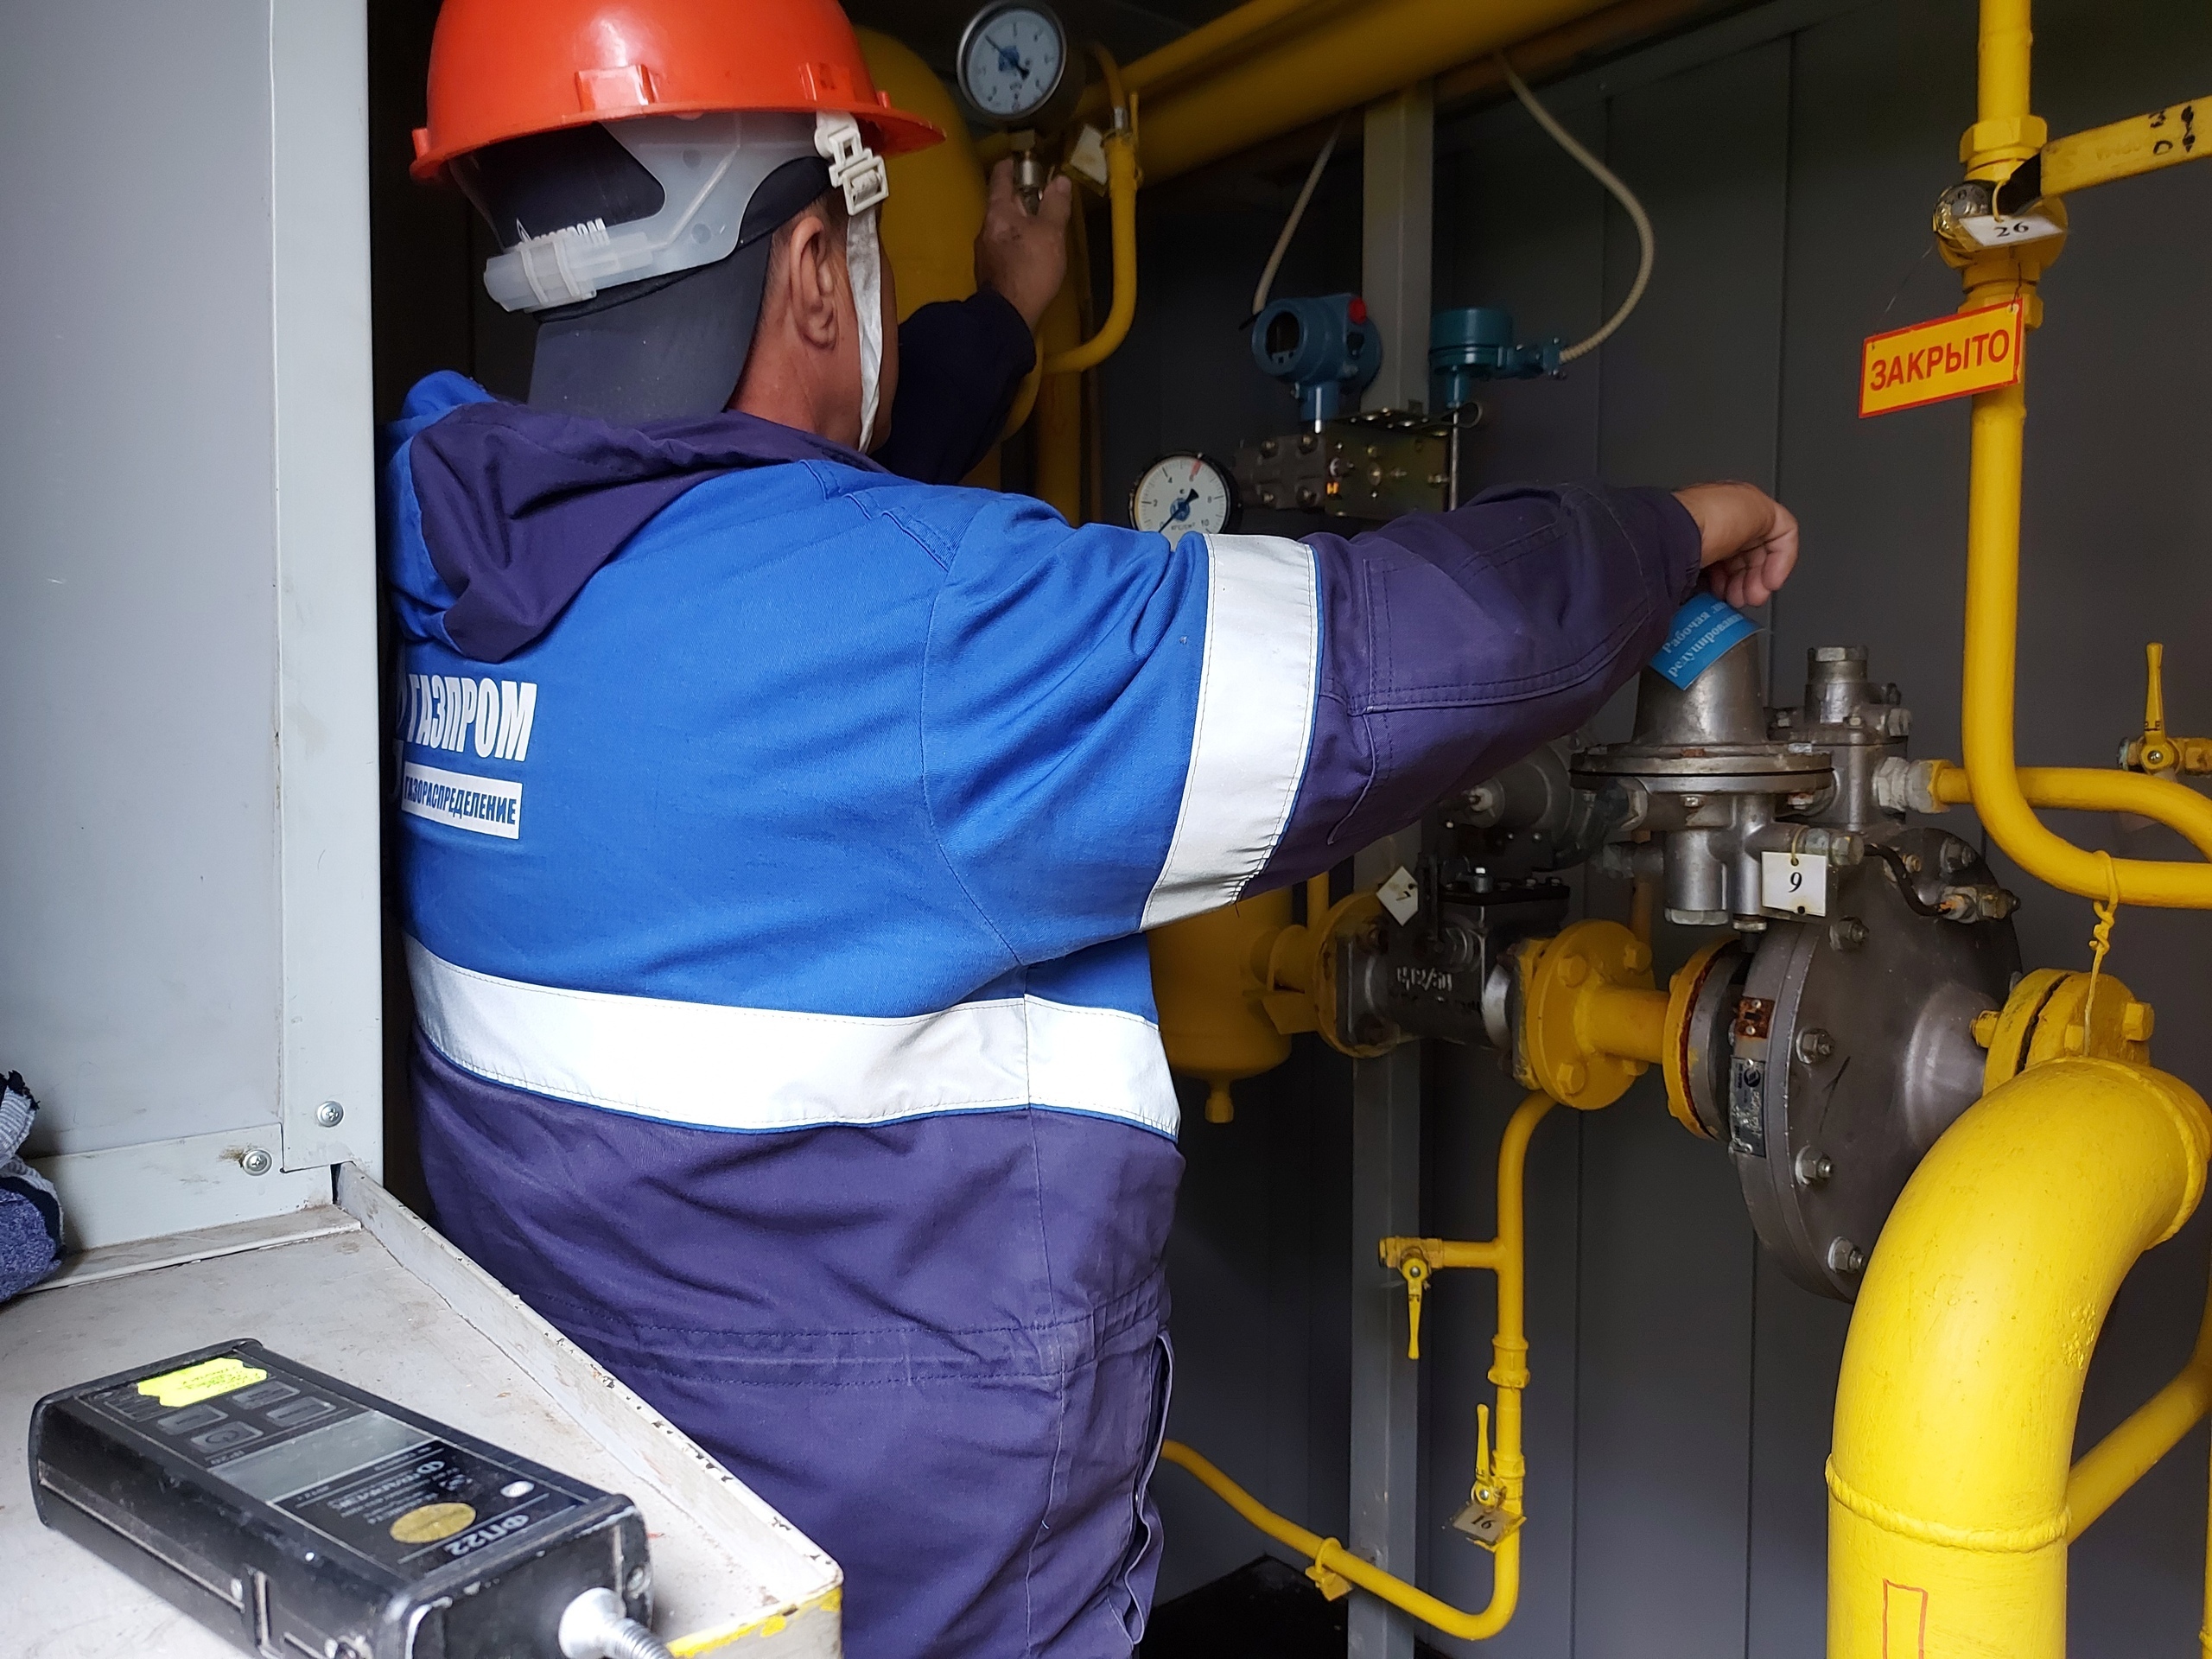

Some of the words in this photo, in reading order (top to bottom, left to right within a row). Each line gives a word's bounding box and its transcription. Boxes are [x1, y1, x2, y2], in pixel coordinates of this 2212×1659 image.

[1994, 220, 2030, 238] 26
[1870, 328, 2011, 391] ЗАКРЫТО
[1201, 518, 1210, 527] 10
[1662, 611, 1710, 653] Рабочая
[407, 673, 537, 762] ГАЗПРОМ
[404, 776, 518, 824] ГАЗОРАСПРЕДЕЛЕНИЕ
[1788, 871, 1802, 893] 9
[443, 1514, 530, 1556] ФП22
[1471, 1515, 1497, 1529] 16
